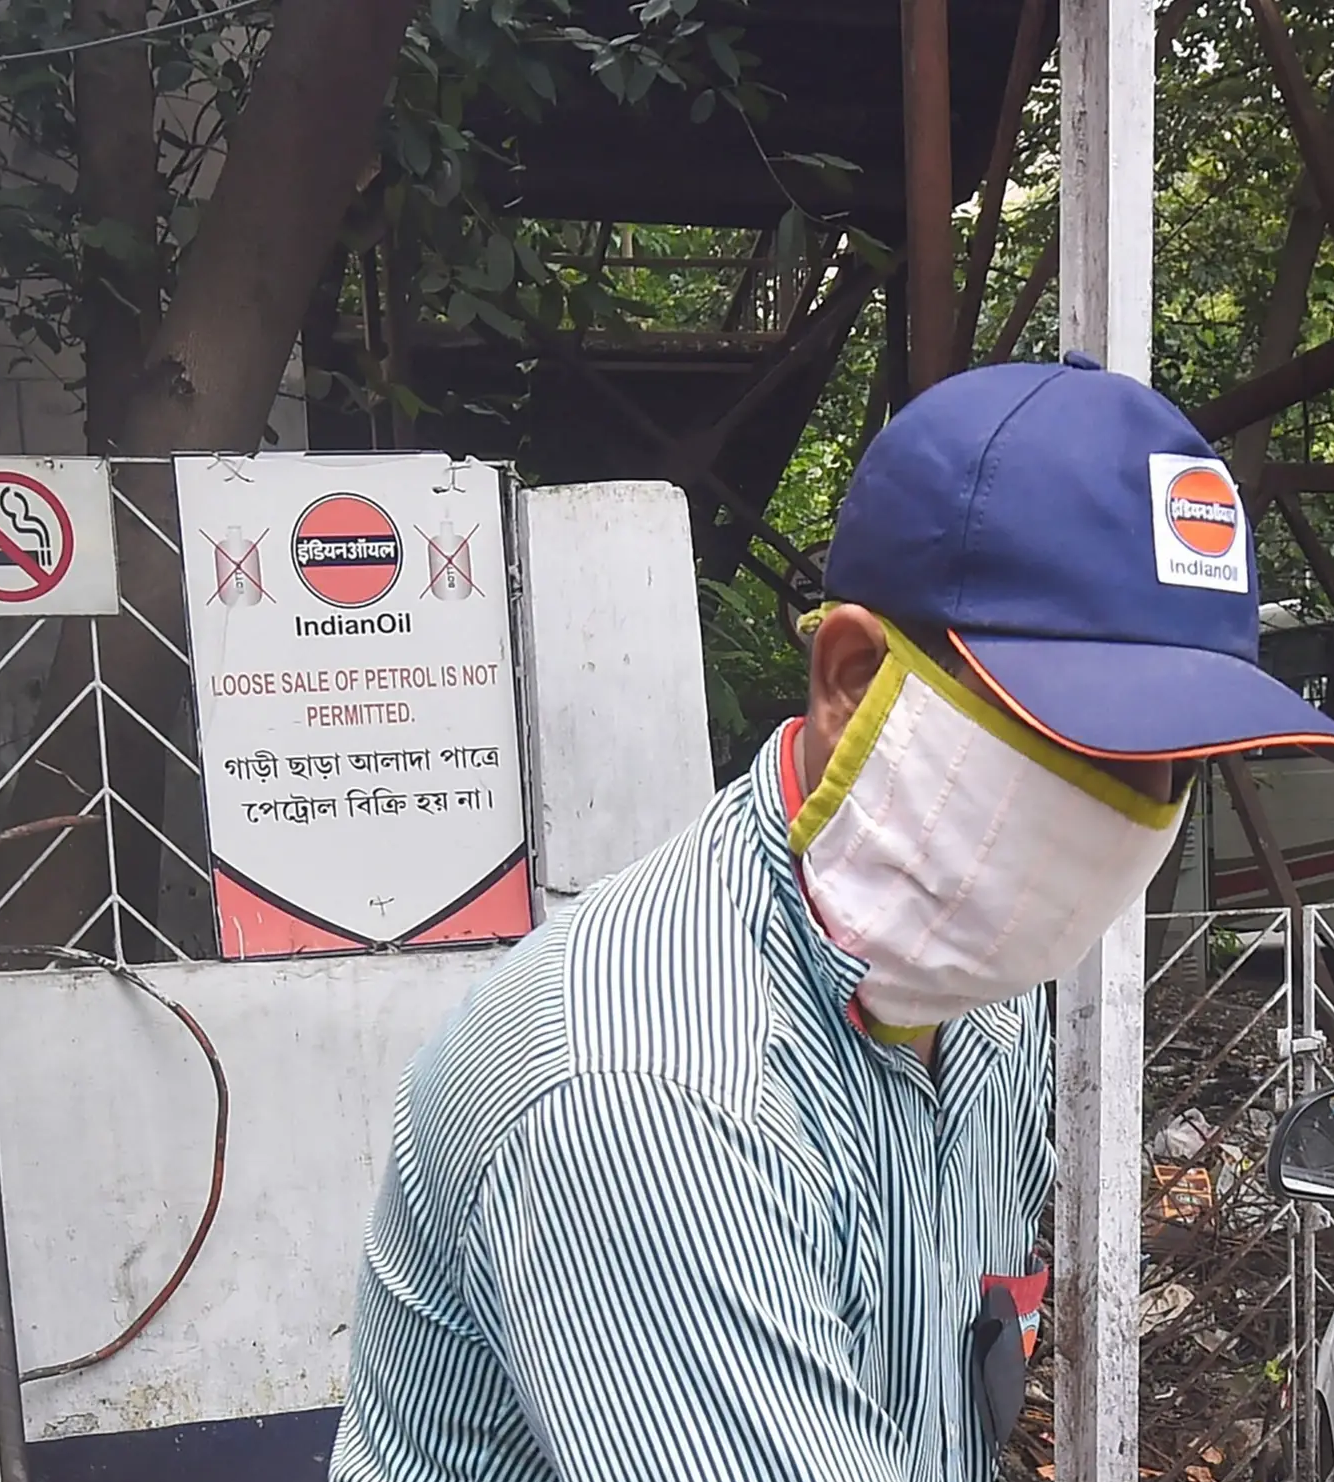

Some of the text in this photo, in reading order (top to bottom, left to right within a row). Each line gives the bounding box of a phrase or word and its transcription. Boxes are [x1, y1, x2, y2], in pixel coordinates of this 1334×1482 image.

[1169, 558, 1238, 582] IndianOil
[295, 612, 411, 637] IndianOil
[211, 664, 498, 697] LOOSE SALE OF PETROL IS NOT
[307, 702, 416, 727] PERMITTED.
[286, 753, 341, 780] ছাড়া
[348, 748, 430, 775] আলাদা
[439, 746, 501, 770] পাত্রে
[242, 793, 337, 825] পেট্রোল
[345, 788, 407, 818] বিক্রি
